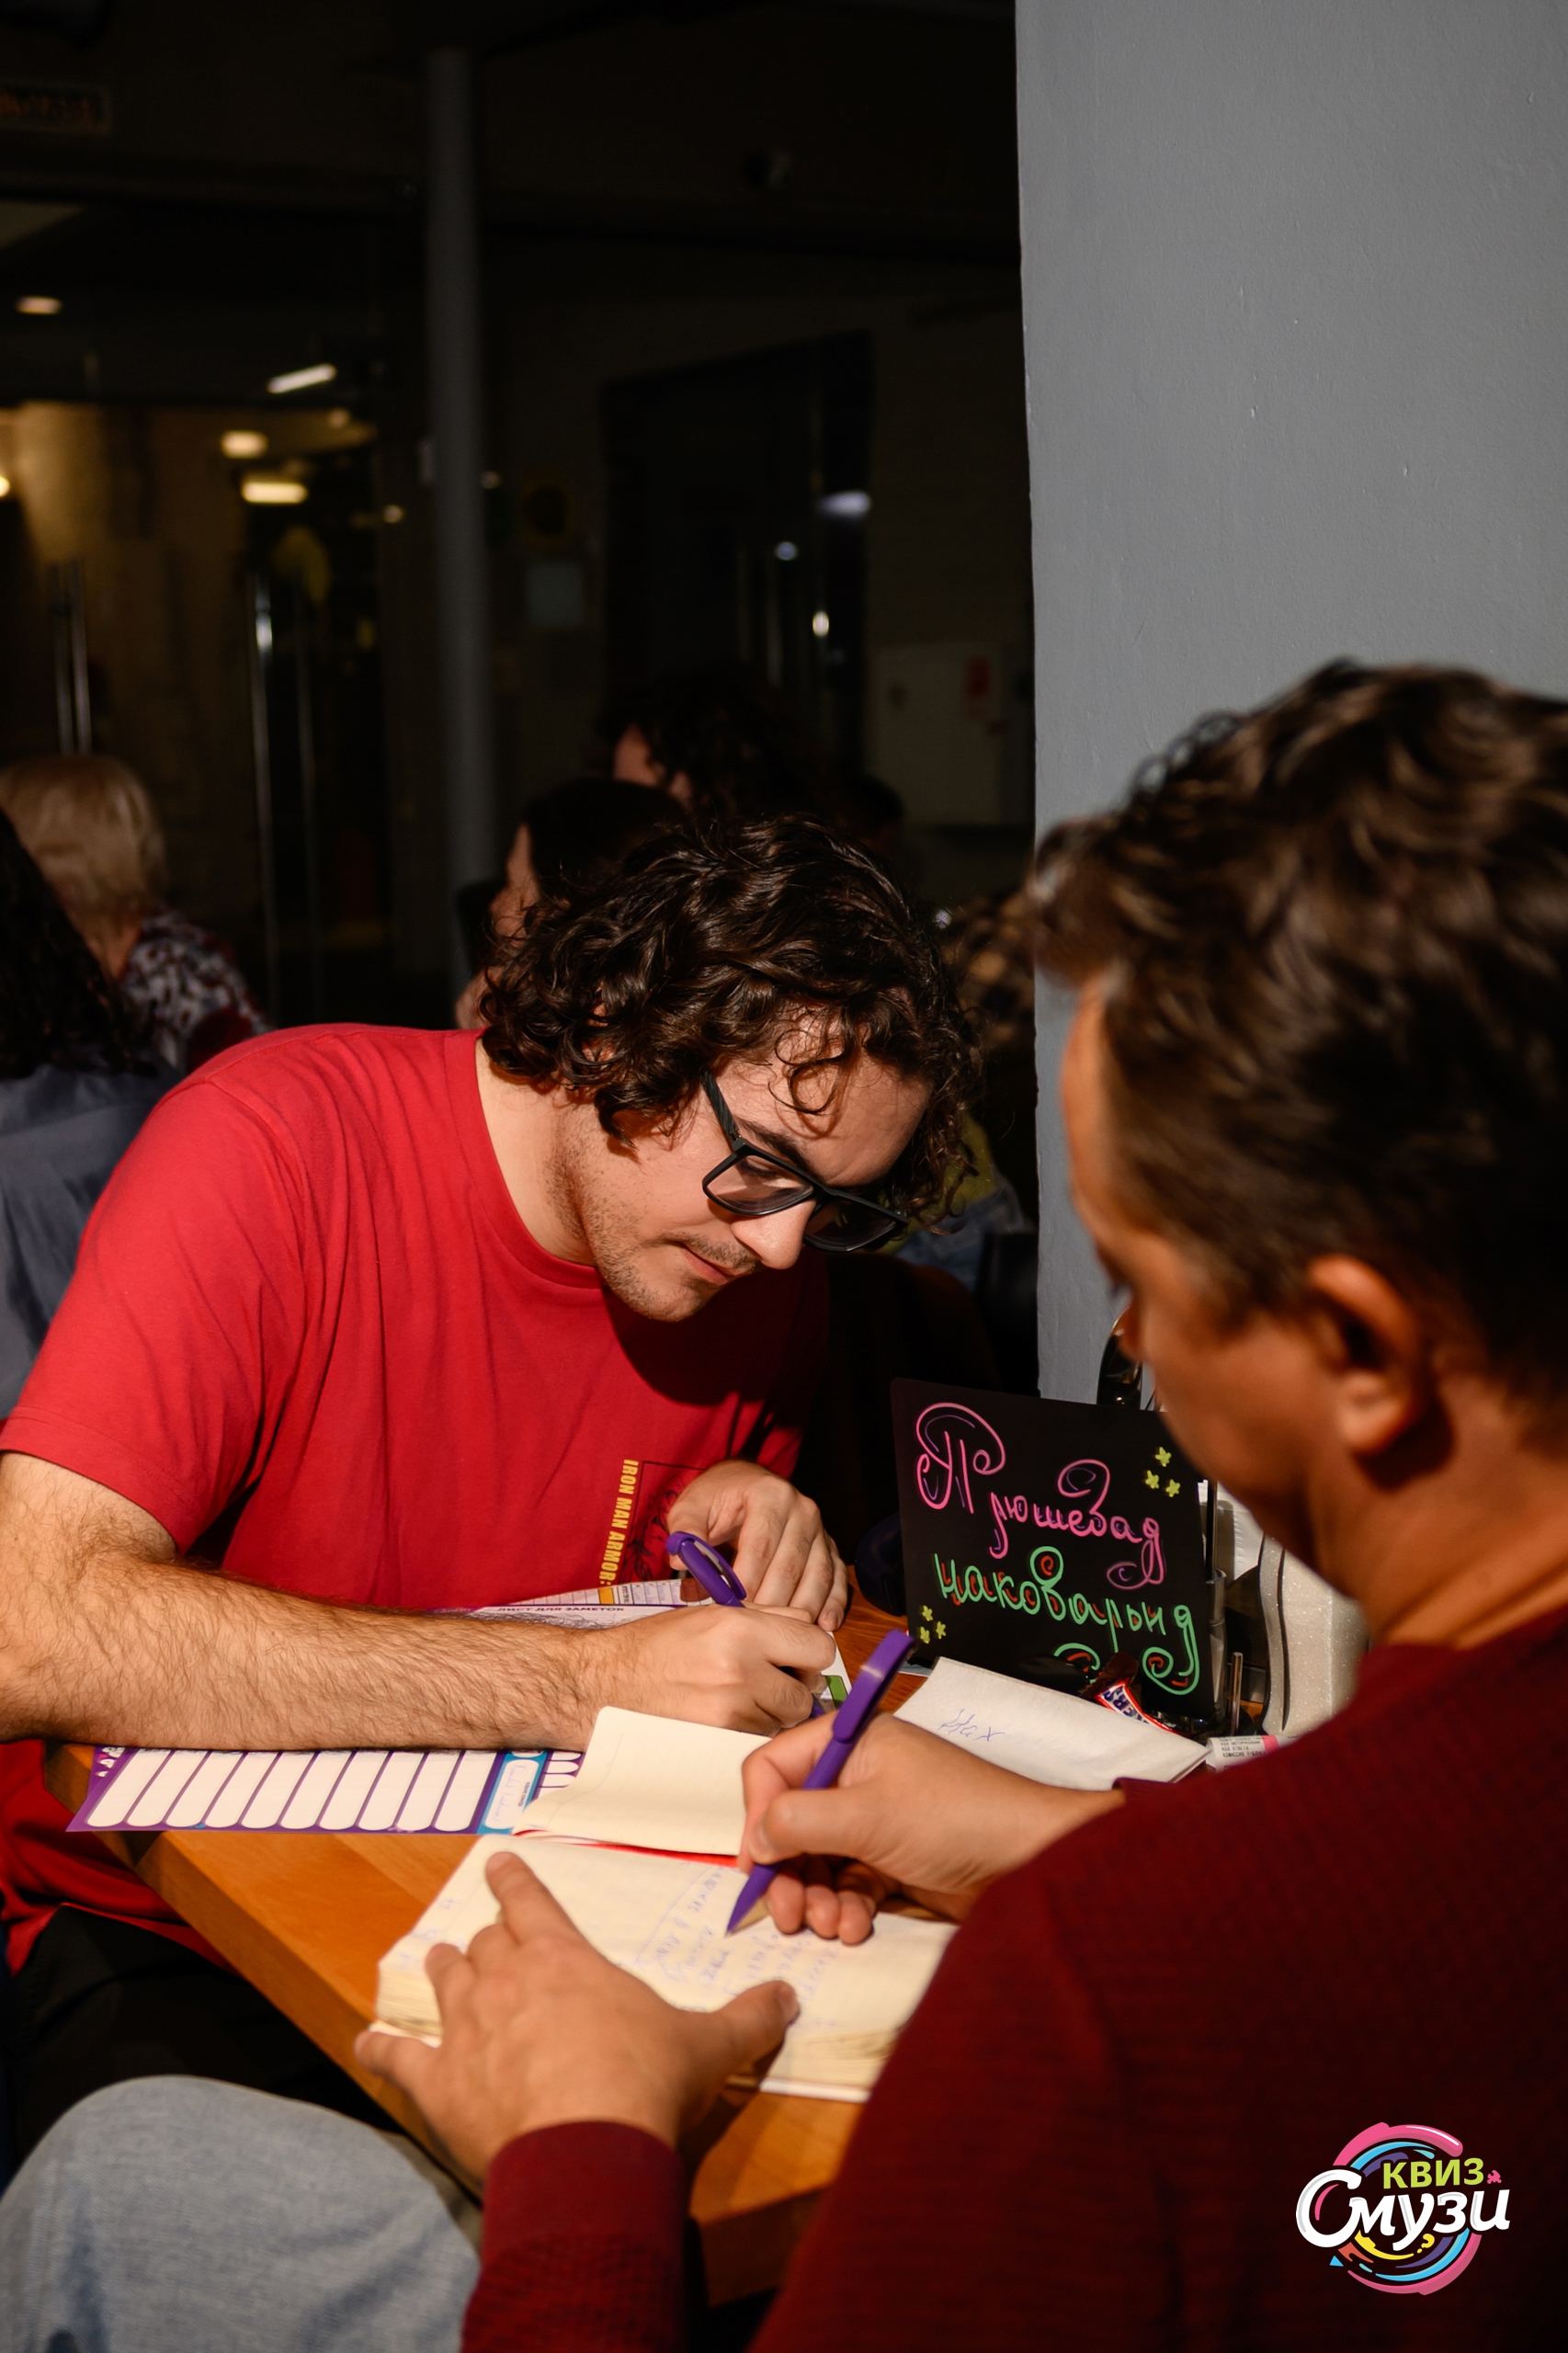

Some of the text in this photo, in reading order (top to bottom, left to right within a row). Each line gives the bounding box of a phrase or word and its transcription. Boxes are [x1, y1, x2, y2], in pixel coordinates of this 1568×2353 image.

[598, 1459, 640, 1586] IRON MAN ARMOR:
